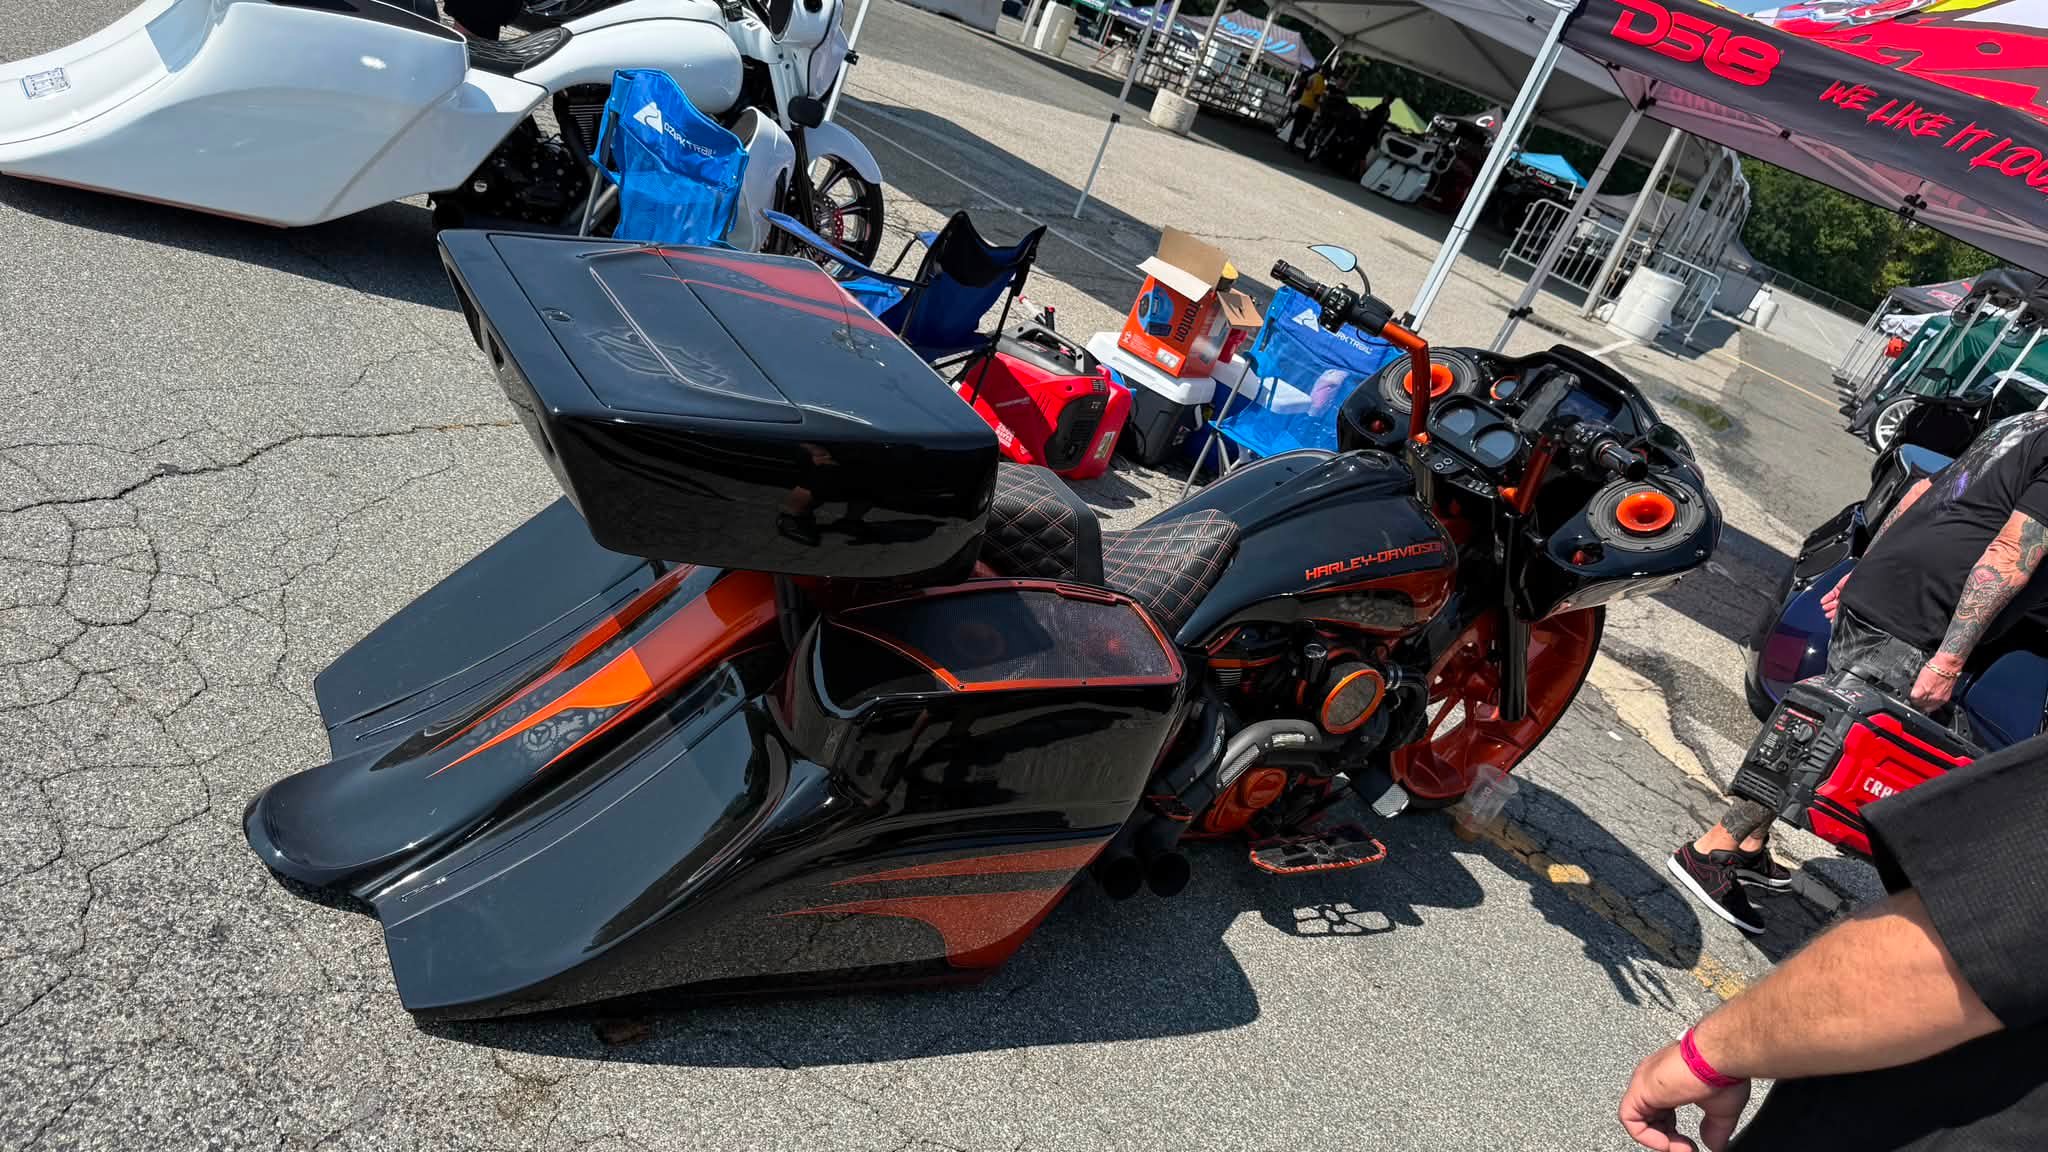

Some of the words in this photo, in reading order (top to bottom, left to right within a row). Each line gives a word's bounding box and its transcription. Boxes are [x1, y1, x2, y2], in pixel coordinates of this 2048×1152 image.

[1610, 0, 1781, 86] DS18
[1819, 80, 1879, 111] WE
[1866, 99, 1956, 137] LIKE
[1942, 121, 1998, 152] IT
[1968, 137, 2048, 194] LOU
[1305, 541, 1442, 581] HARLEY-DAVIDSO
